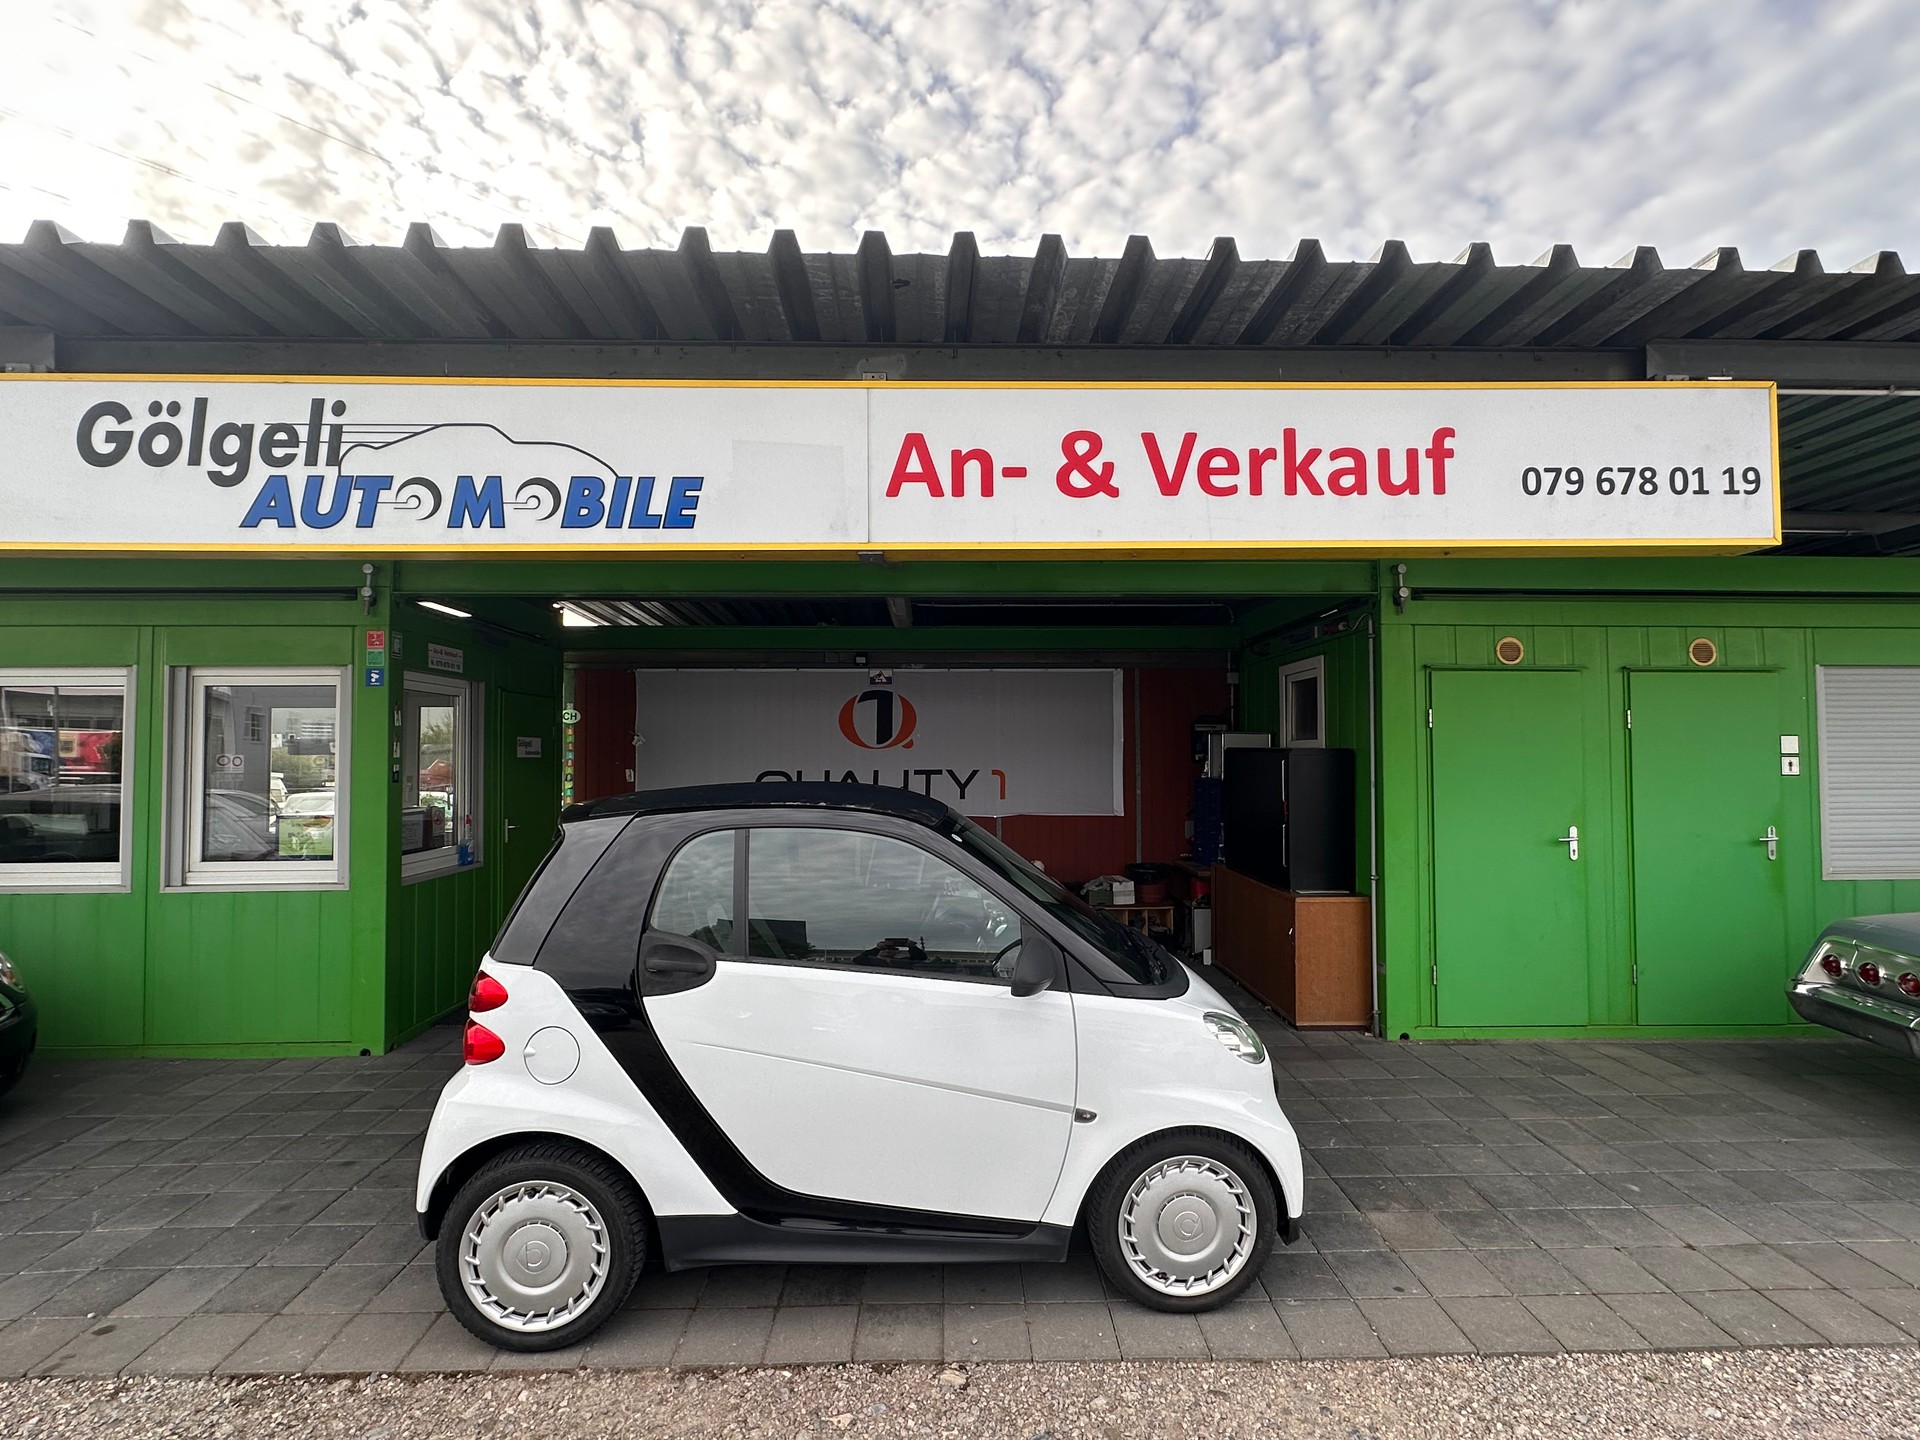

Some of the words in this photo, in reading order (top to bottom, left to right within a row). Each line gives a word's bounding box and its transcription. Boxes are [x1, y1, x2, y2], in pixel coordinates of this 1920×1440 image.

[76, 397, 347, 488] Gölgeli
[885, 432, 1028, 498] An-
[1055, 430, 1121, 499] &
[1140, 427, 1456, 498] Verkauf
[1521, 466, 1584, 496] 079
[1596, 466, 1659, 496] 678
[1669, 466, 1710, 496] 01
[1722, 466, 1761, 496] 19
[563, 712, 577, 721] CH
